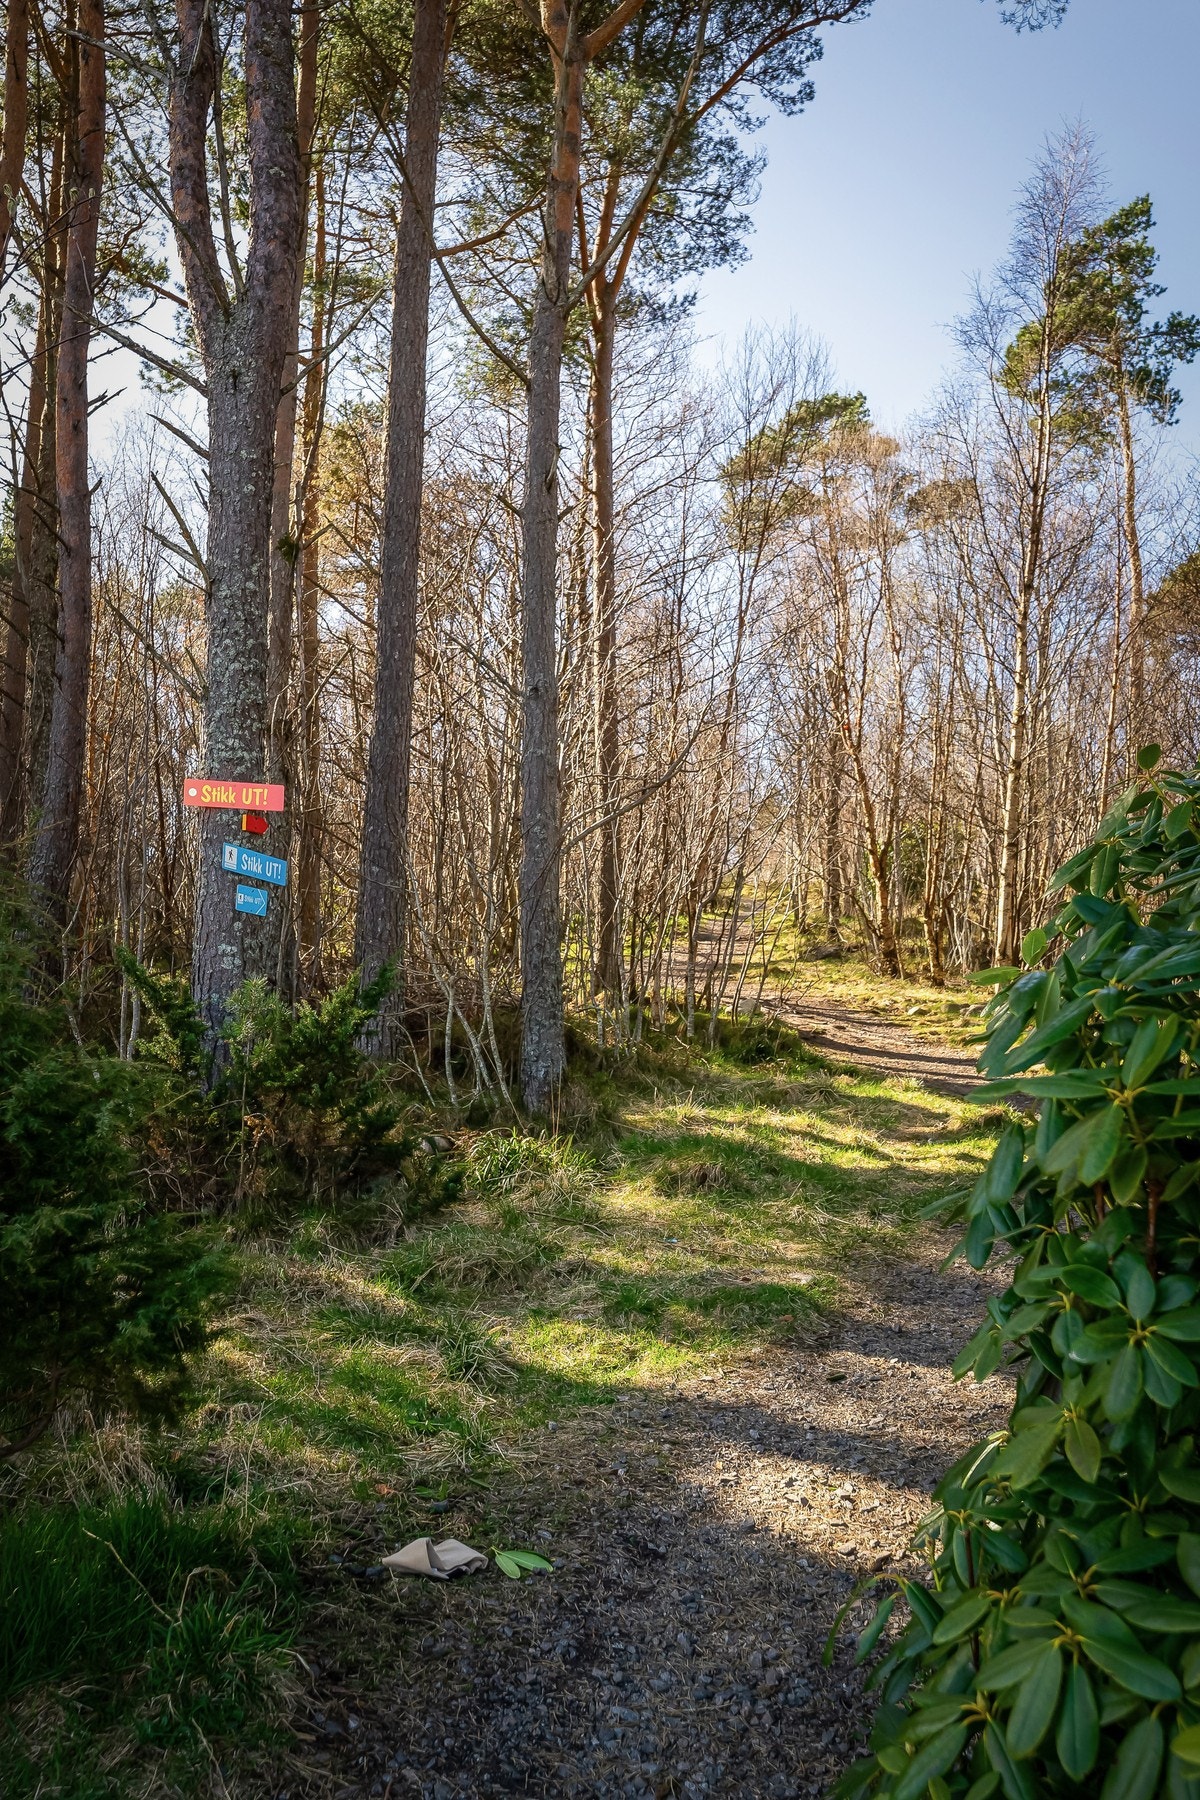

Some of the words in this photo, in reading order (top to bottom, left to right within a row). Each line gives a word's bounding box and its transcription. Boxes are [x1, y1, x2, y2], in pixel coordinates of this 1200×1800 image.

[201, 784, 236, 804] Stikk
[241, 787, 268, 806] UT!
[240, 853, 263, 874] Stikk
[265, 861, 282, 880] UT!
